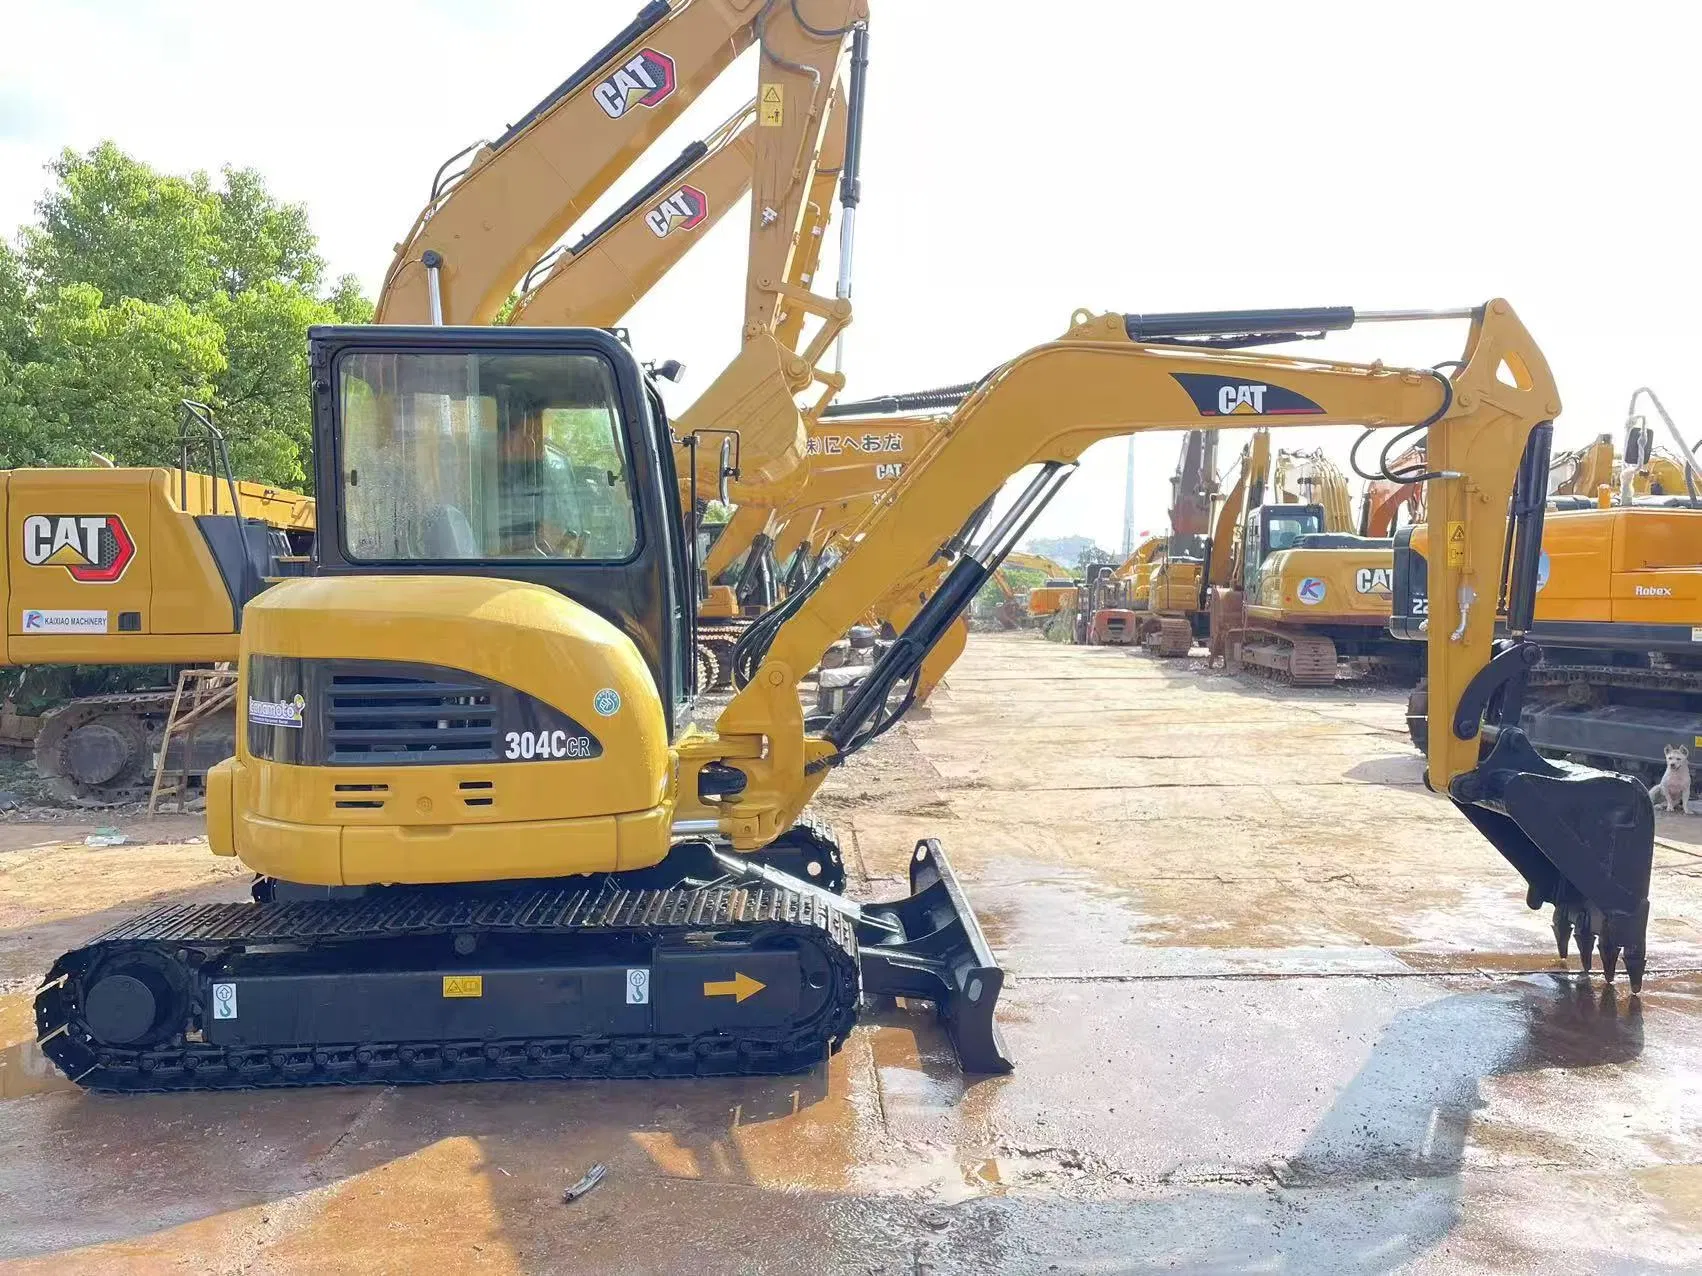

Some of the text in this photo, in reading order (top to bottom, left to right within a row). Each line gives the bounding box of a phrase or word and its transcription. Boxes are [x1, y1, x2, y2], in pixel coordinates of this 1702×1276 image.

[593, 54, 657, 118] CAT
[645, 190, 693, 238] CAT
[1219, 385, 1267, 414] CAT
[876, 463, 902, 480] CAT
[24, 516, 107, 565] CAT
[1635, 585, 1672, 596] Robex
[44, 616, 106, 626] KAIXIAO MACHINERY
